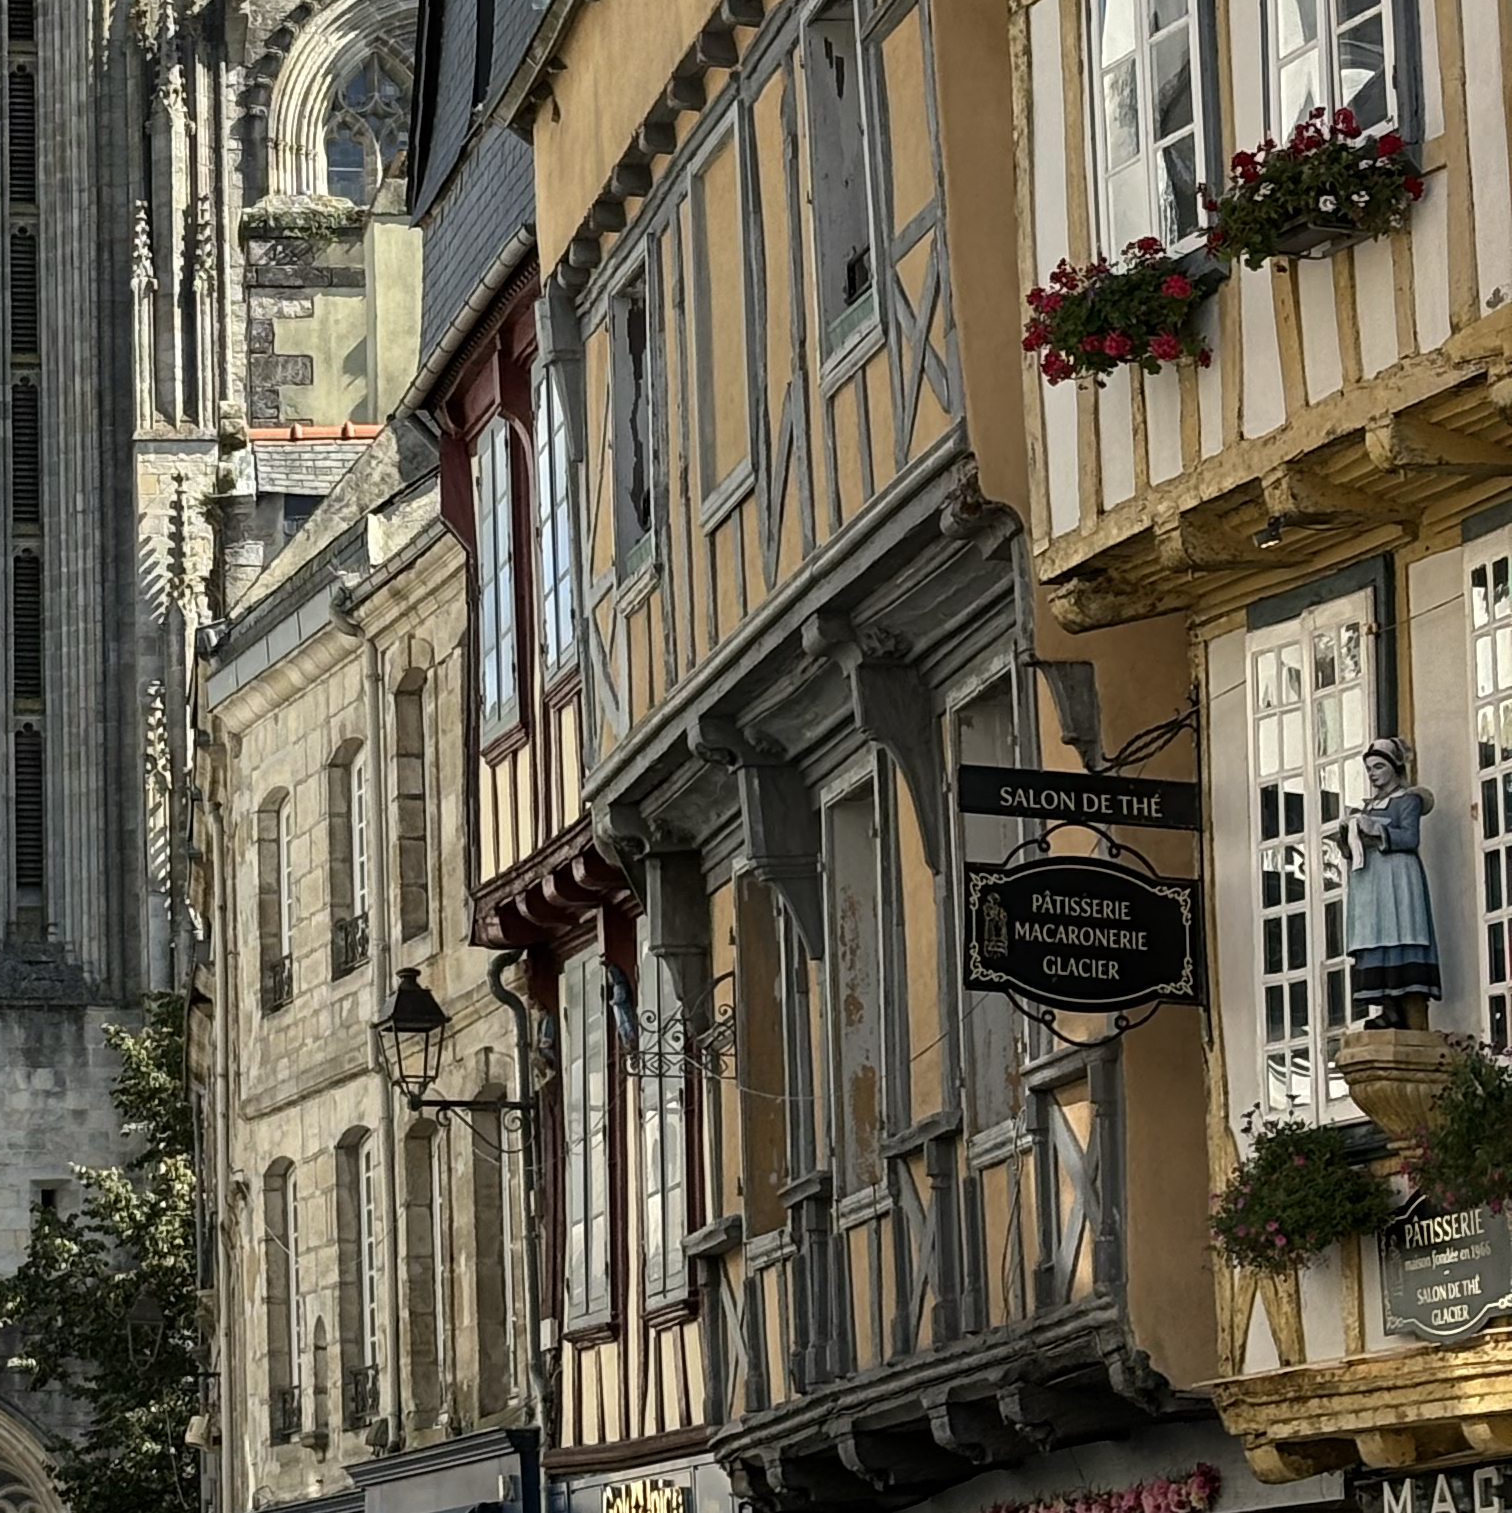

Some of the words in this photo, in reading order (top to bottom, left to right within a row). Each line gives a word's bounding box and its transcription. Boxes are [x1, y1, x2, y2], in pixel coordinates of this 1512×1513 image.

[1000, 786, 1076, 812] SALON
[1082, 793, 1114, 814] DE
[1117, 794, 1163, 818] THÉ
[1032, 890, 1132, 921] PÂTISSERIE
[1014, 920, 1149, 951] MACARONERIE
[1042, 955, 1120, 980] GLACIER
[1404, 1208, 1485, 1250] PÂTISSERIE
[1459, 1248, 1471, 1260] en
[1416, 1284, 1447, 1306] SALON
[1448, 1281, 1461, 1300] DE
[1462, 1273, 1482, 1295] THÉ
[1431, 1304, 1471, 1326] GLACIER
